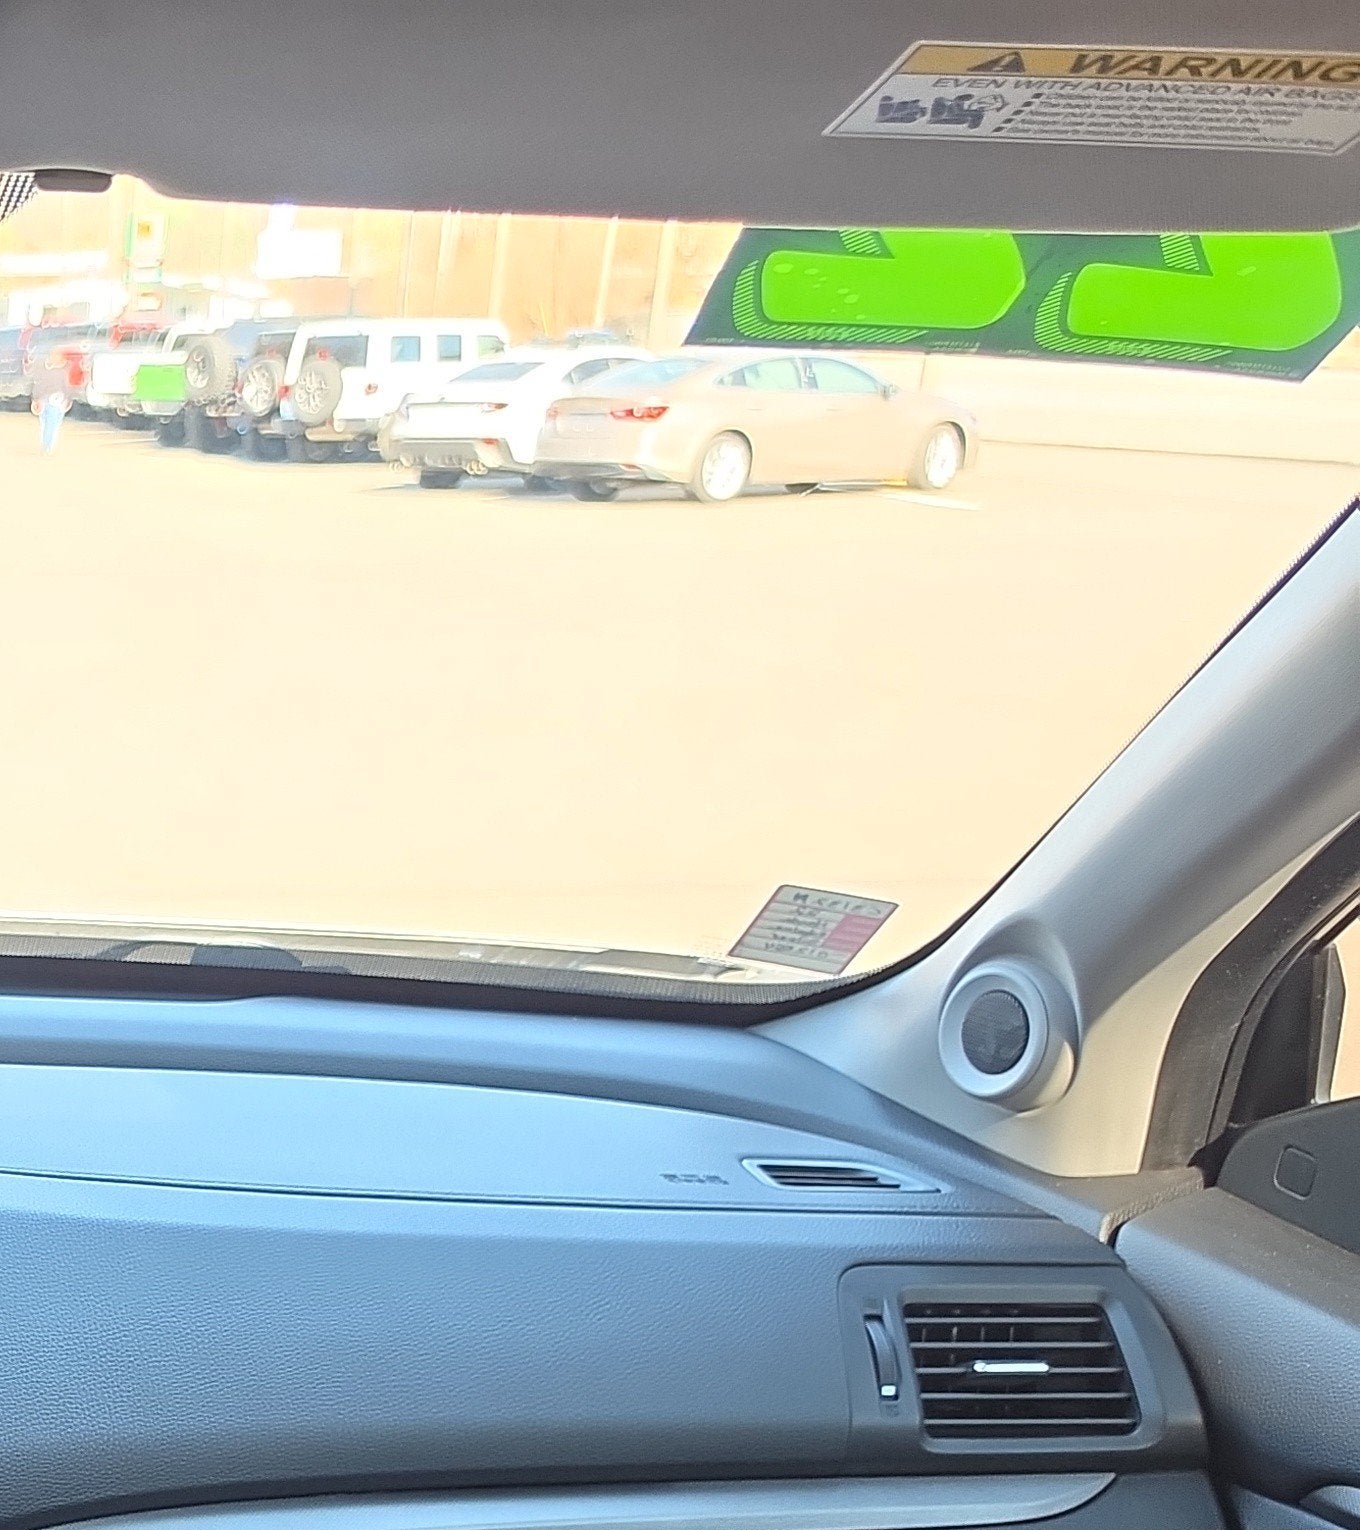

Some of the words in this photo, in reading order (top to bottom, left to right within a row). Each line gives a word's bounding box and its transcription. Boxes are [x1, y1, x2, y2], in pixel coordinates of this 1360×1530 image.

[1069, 52, 1360, 83] WARNING
[931, 77, 1006, 89] EVEN
[1014, 79, 1088, 92] WITH
[1084, 81, 1231, 96] ADVANCED
